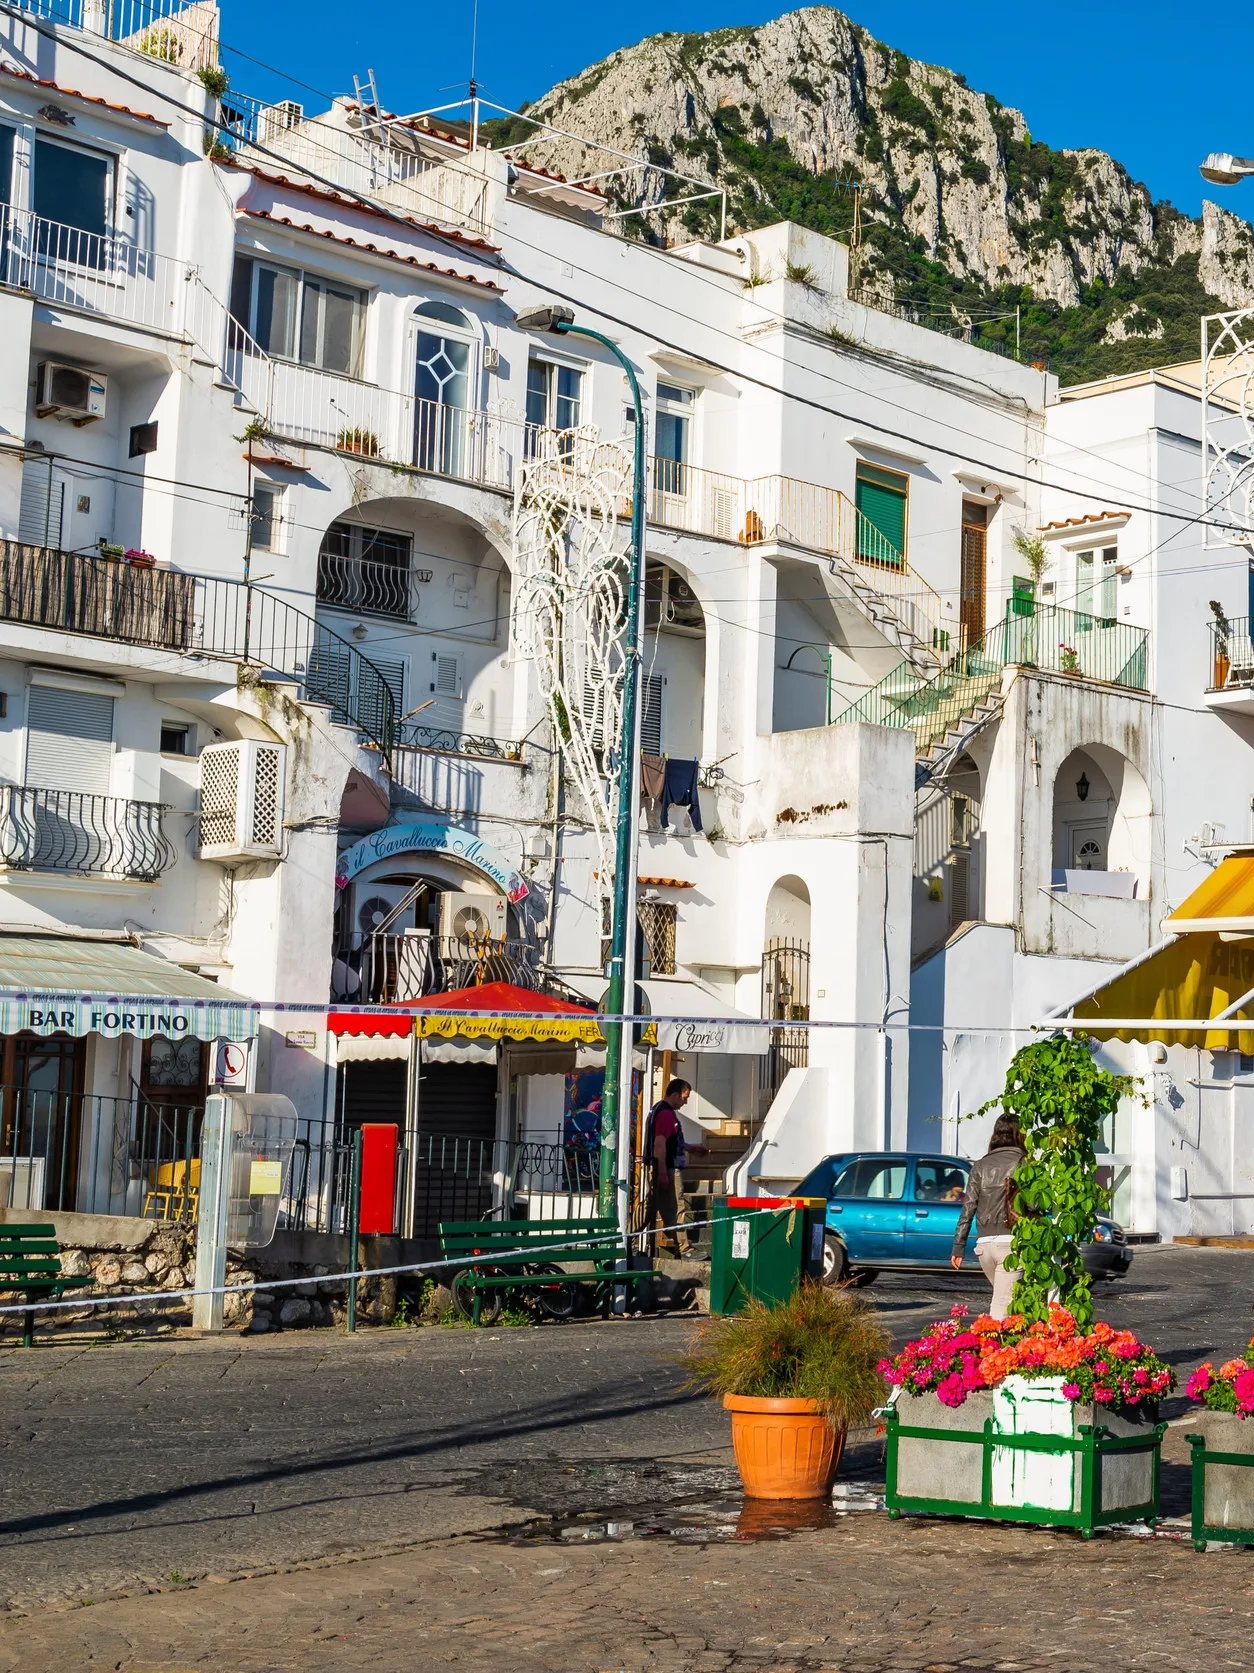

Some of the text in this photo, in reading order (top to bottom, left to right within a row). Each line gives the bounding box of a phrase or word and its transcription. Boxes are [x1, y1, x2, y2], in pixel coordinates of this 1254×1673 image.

[353, 826, 507, 885] il Cavalluccio Marino
[29, 1010, 189, 1032] BAR FORTINO
[456, 1020, 523, 1034] Cavalluccio
[524, 1026, 571, 1036] Marino
